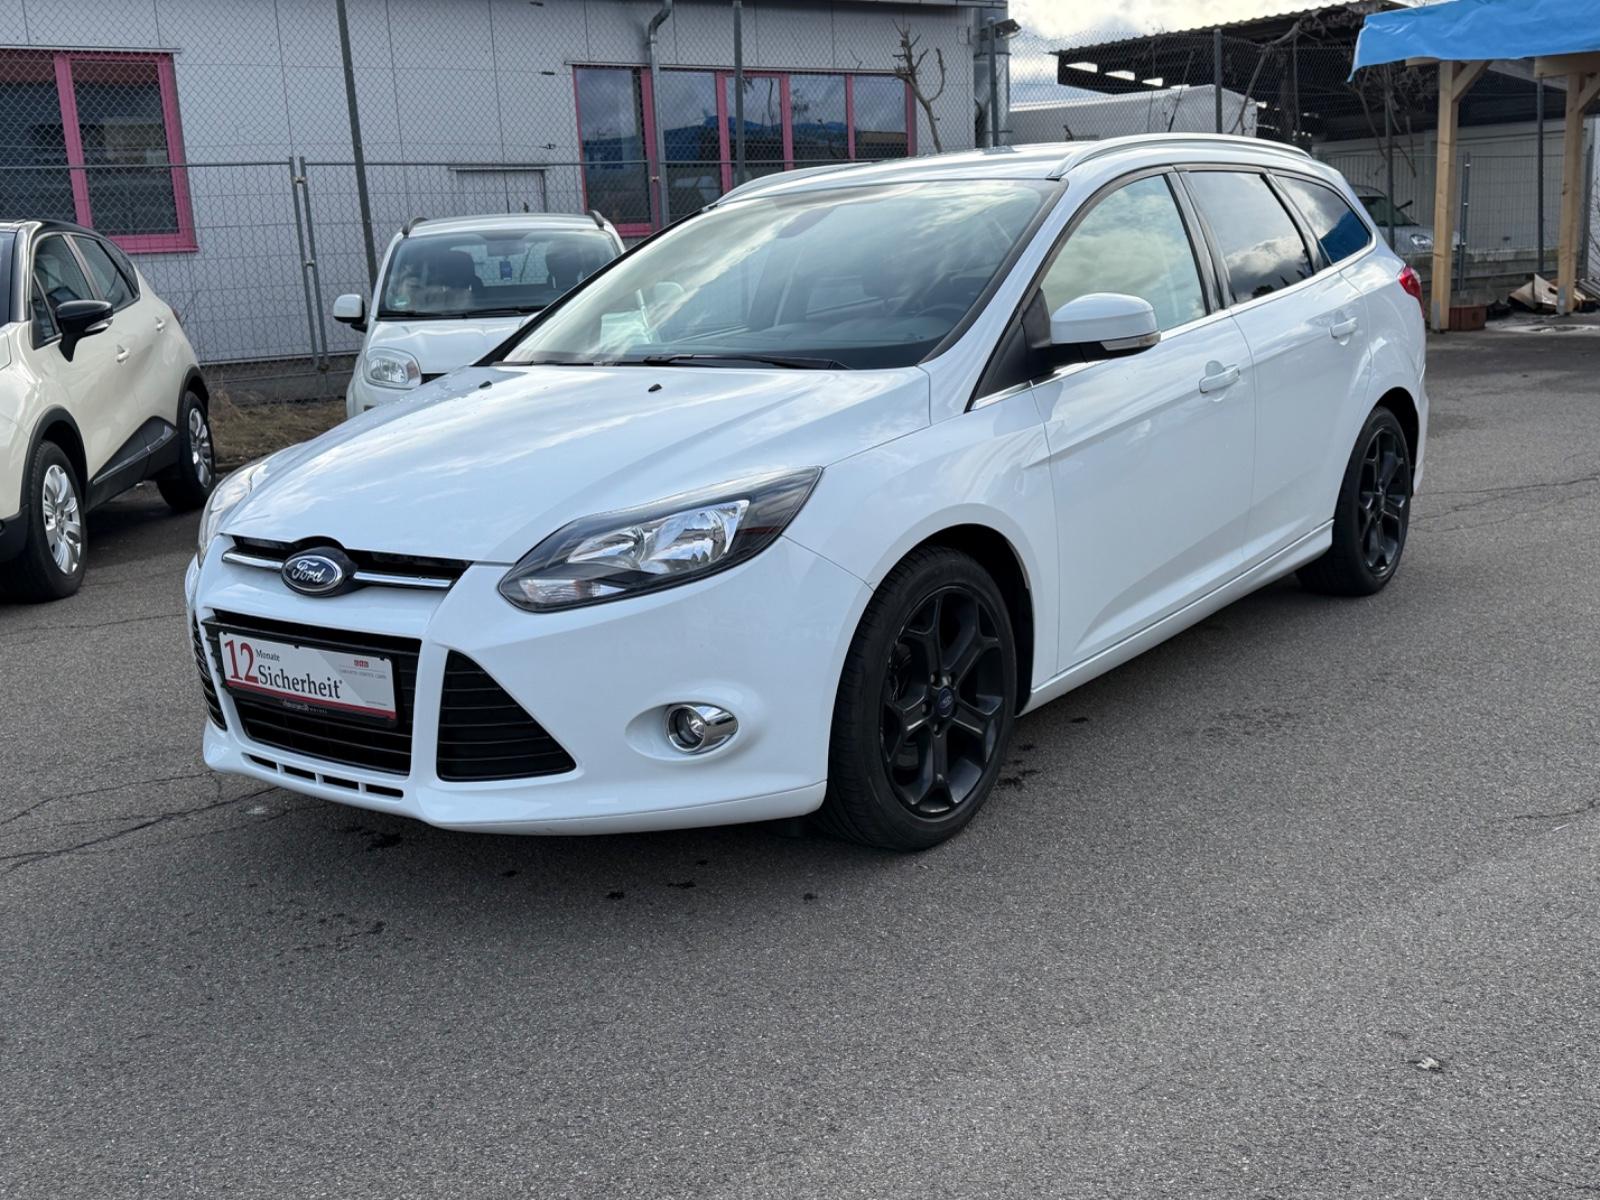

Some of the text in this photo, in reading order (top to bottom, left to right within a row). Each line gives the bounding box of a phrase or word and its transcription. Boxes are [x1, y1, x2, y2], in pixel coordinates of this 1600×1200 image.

[291, 560, 325, 583] Ford
[224, 639, 259, 684] 12
[256, 649, 281, 663] Monate
